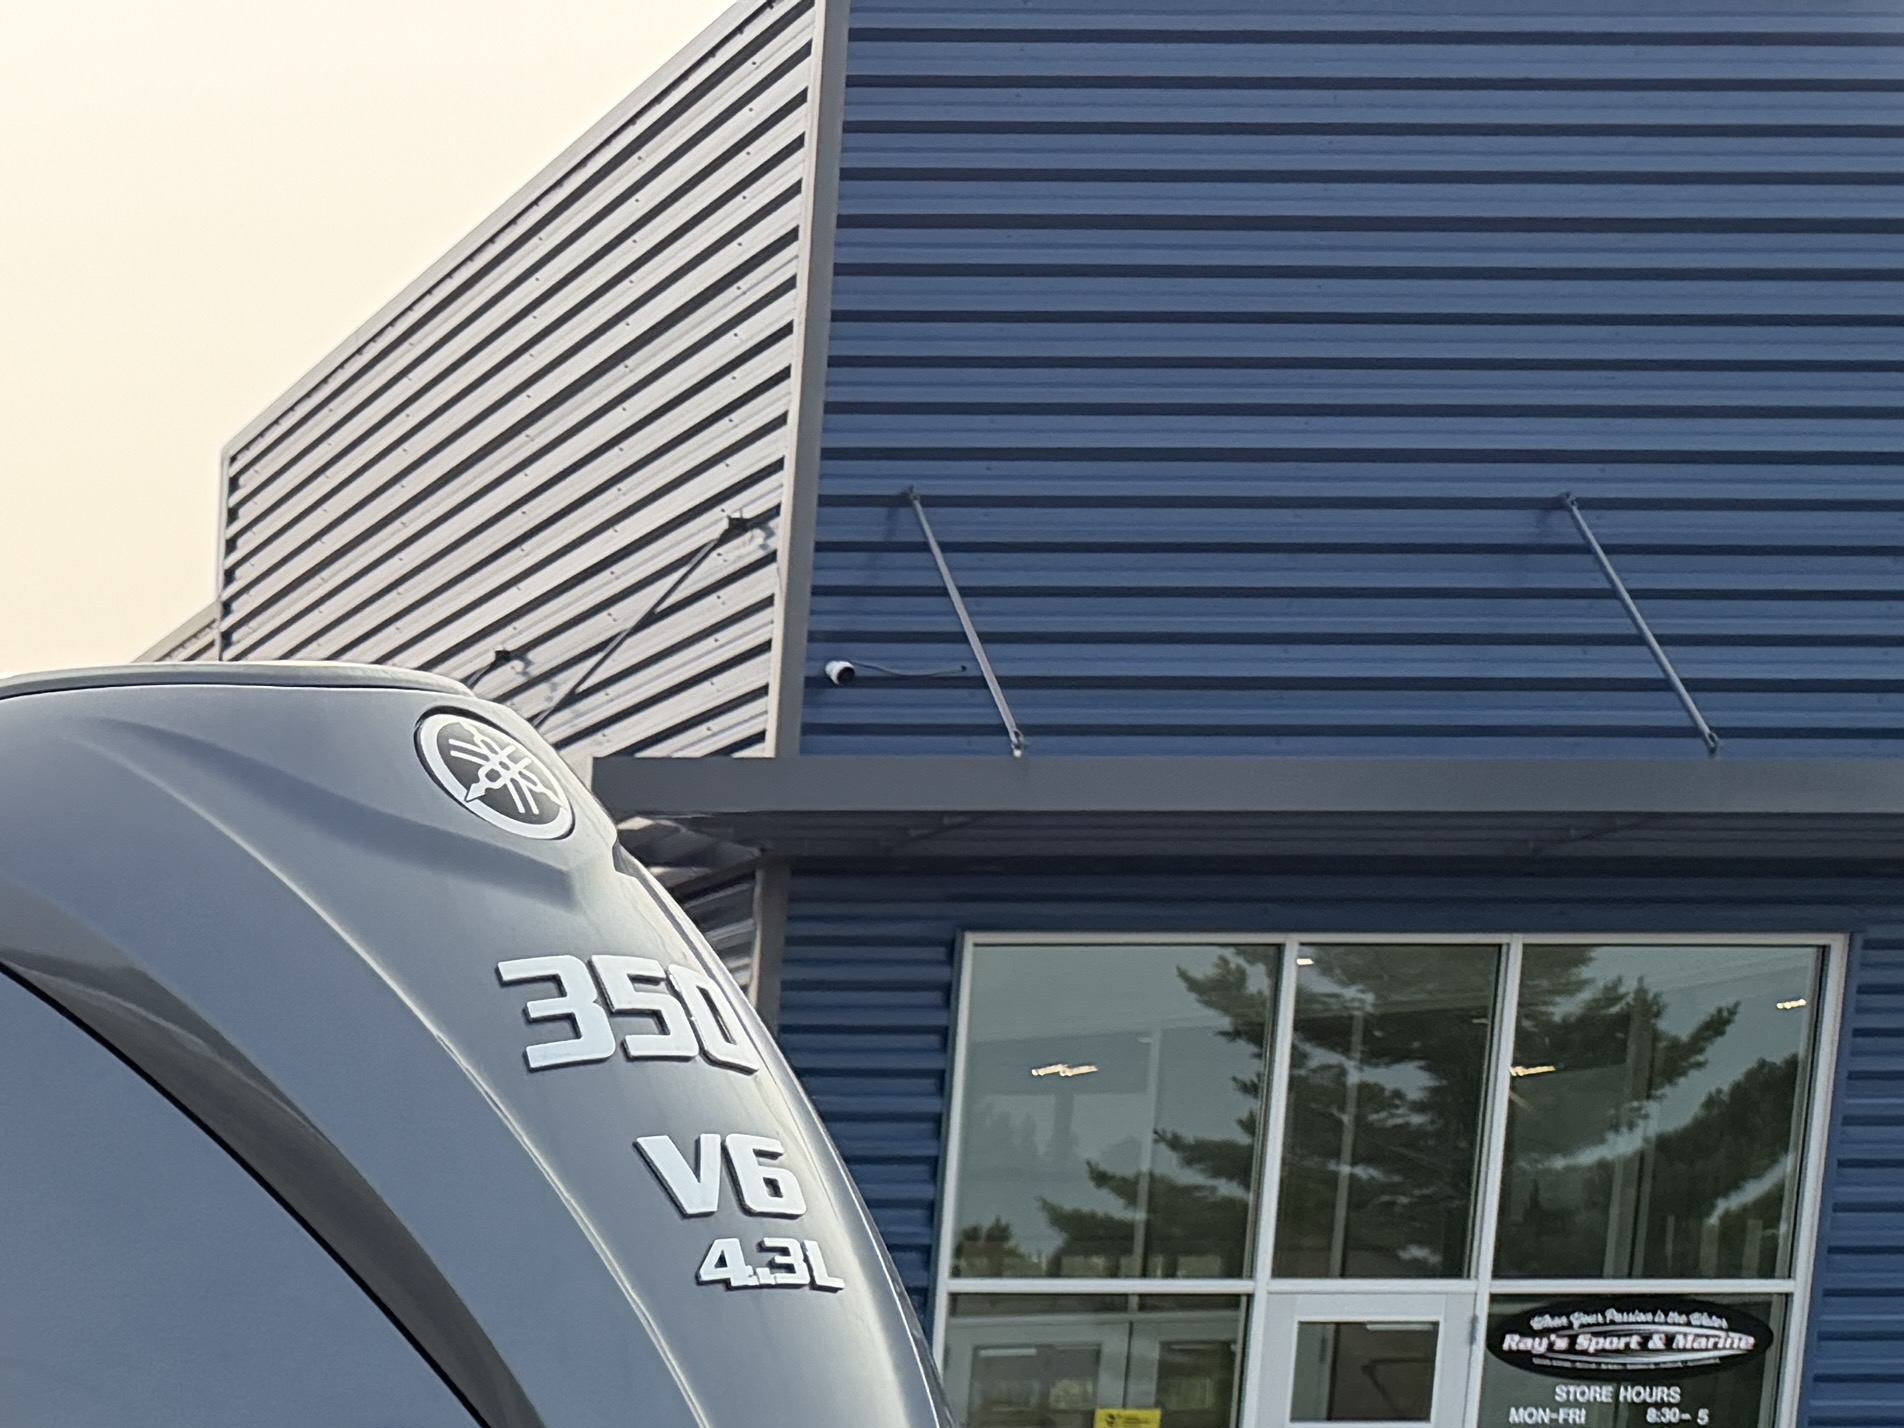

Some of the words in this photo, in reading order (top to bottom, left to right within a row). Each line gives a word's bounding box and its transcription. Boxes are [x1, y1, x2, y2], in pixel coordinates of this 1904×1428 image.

[497, 954, 759, 1075] 350
[632, 1133, 807, 1219] V6
[697, 1237, 845, 1293] 4.3L
[1502, 1333, 1569, 1354] Ray's
[1575, 1333, 1642, 1353] Sport
[1647, 1333, 1666, 1350] &
[1672, 1332, 1755, 1350] Marine
[1555, 1385, 1613, 1402] STORE
[1619, 1386, 1681, 1403] HOURS
[1509, 1407, 1586, 1424] MON-FRI
[1697, 1408, 1710, 1425] 5
